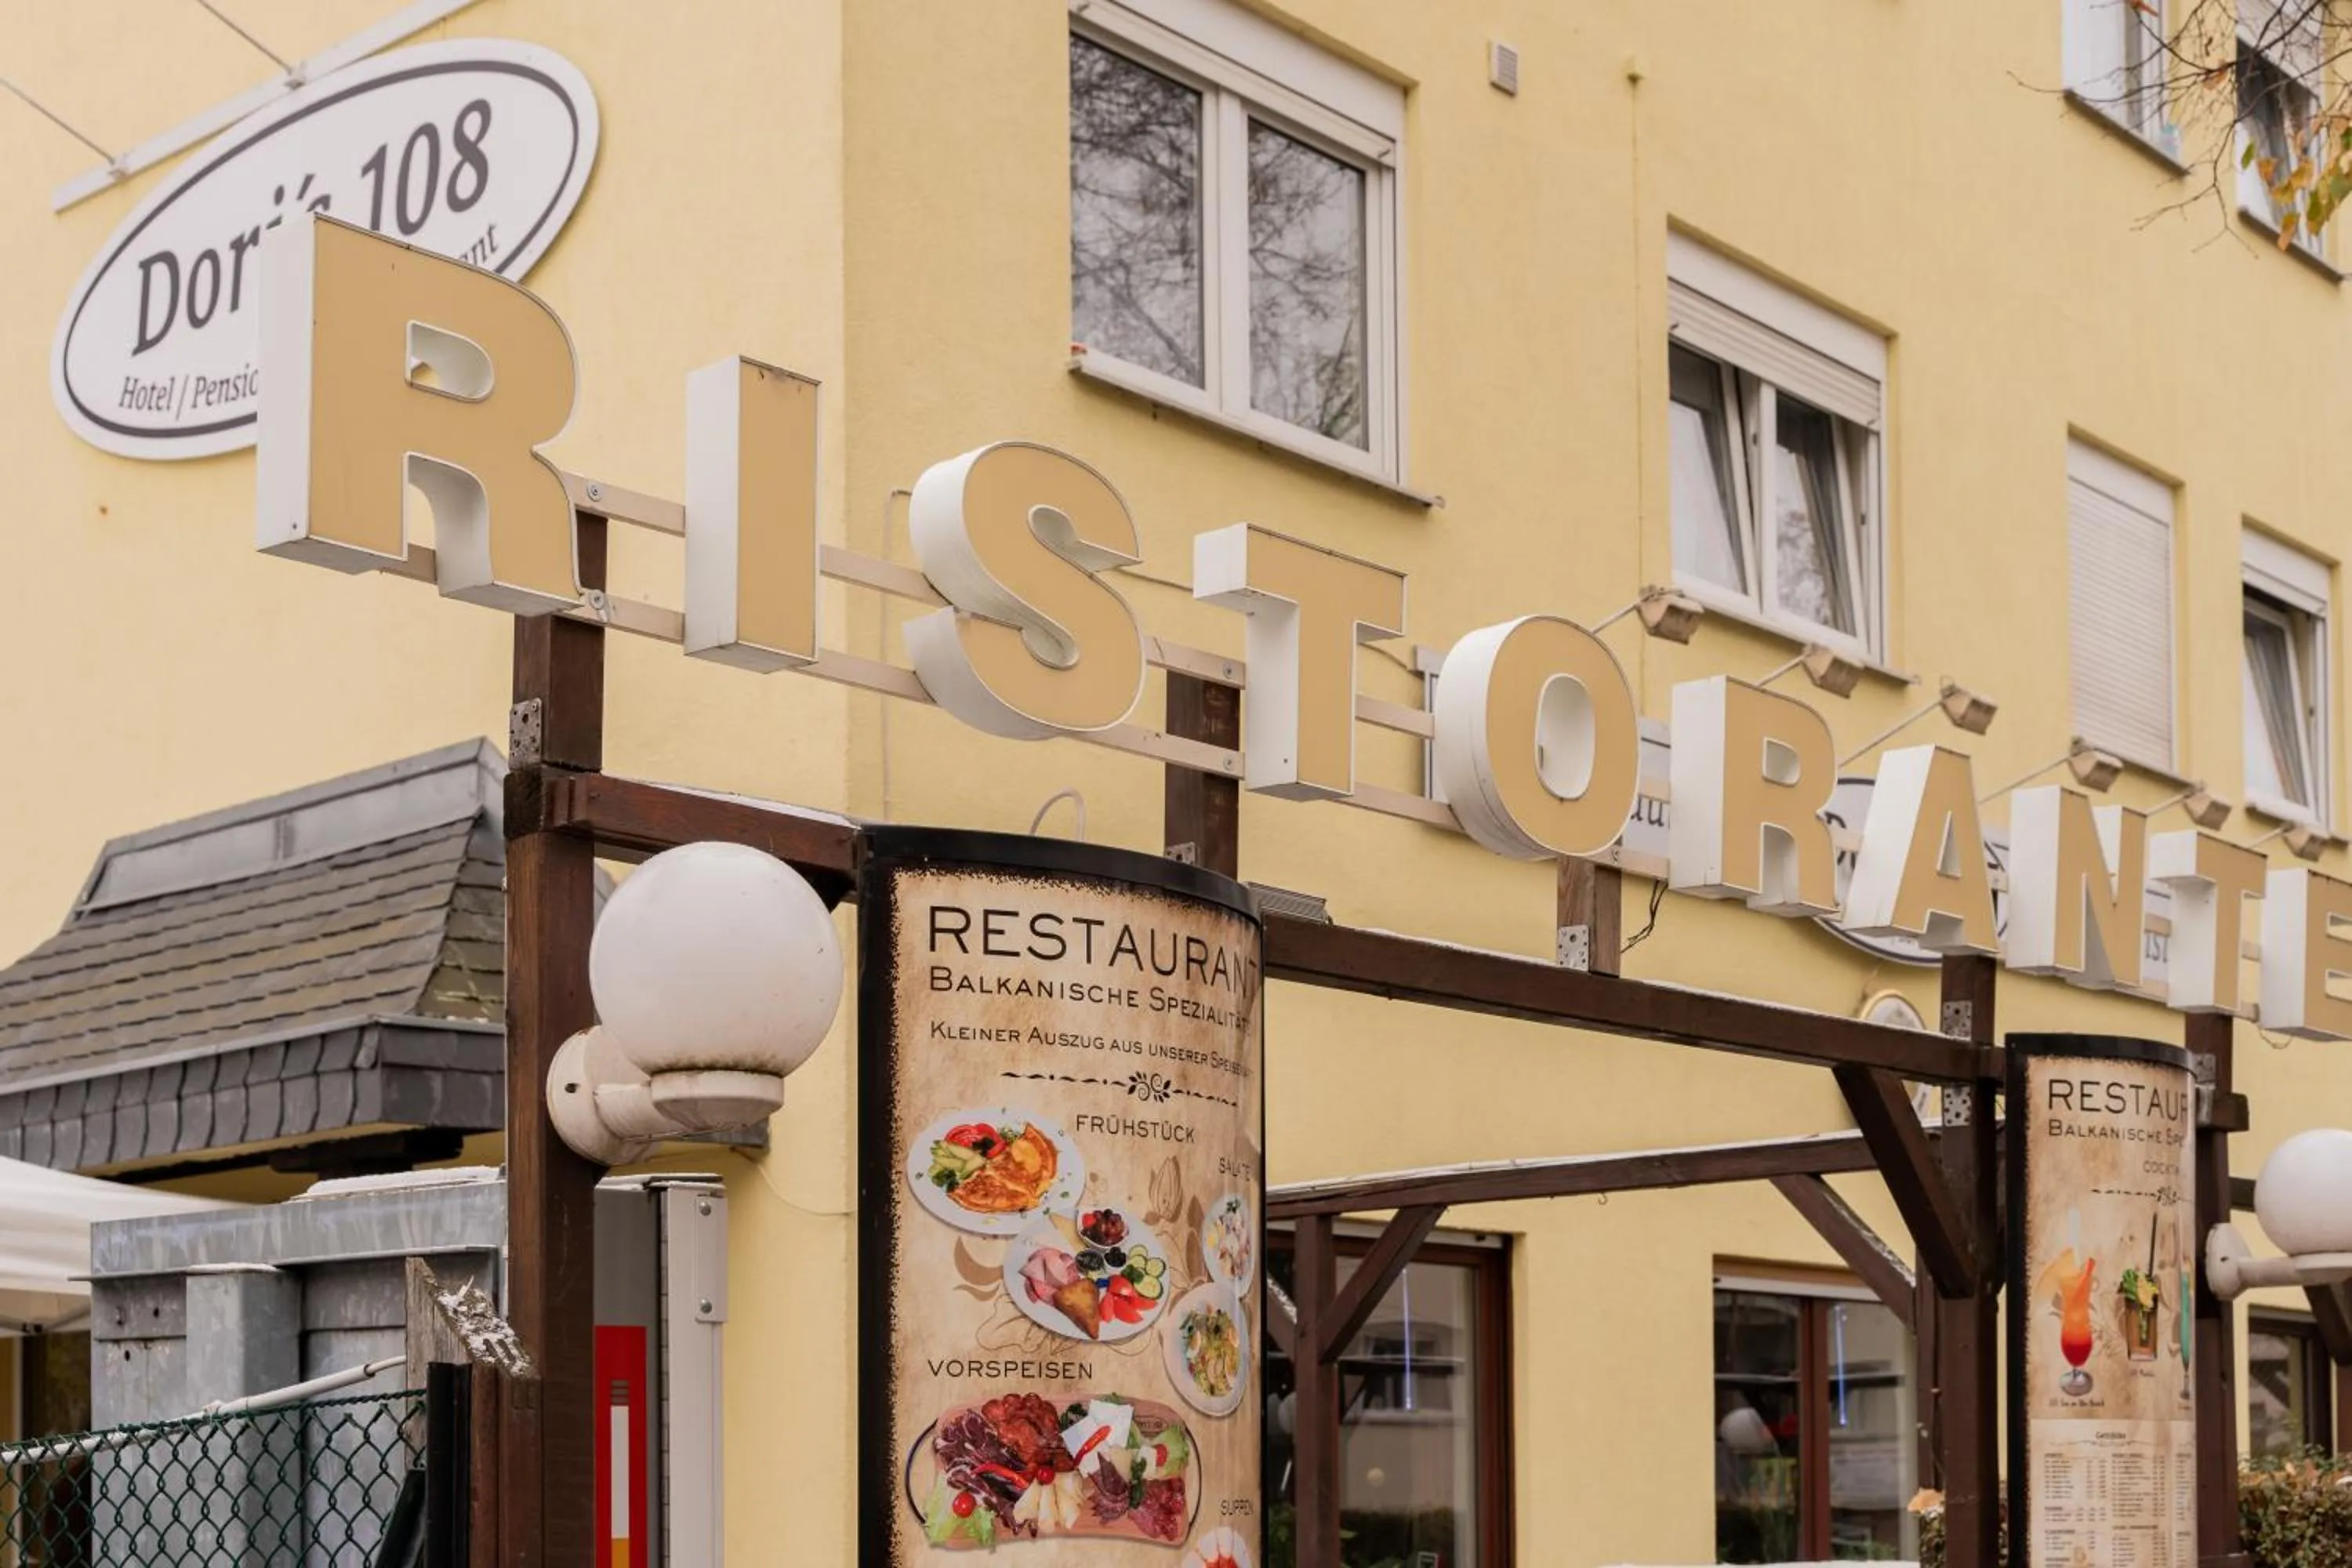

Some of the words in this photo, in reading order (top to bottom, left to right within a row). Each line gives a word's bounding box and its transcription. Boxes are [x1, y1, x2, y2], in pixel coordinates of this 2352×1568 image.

[132, 173, 331, 356] Dor'
[361, 99, 492, 236] 108
[118, 376, 176, 411] Hotel
[191, 363, 259, 409] Pensio
[257, 208, 2352, 1043] RISTORANTE
[930, 965, 1139, 1008] BALKANISCHE
[931, 1020, 1020, 1044] KLEINER
[1027, 1026, 1105, 1051] AUSZUG
[2048, 1079, 2188, 1123] RESTAUR
[1076, 1114, 1196, 1143] FRÜHSTÜCK
[927, 1359, 1093, 1381] VORSPEISEN
